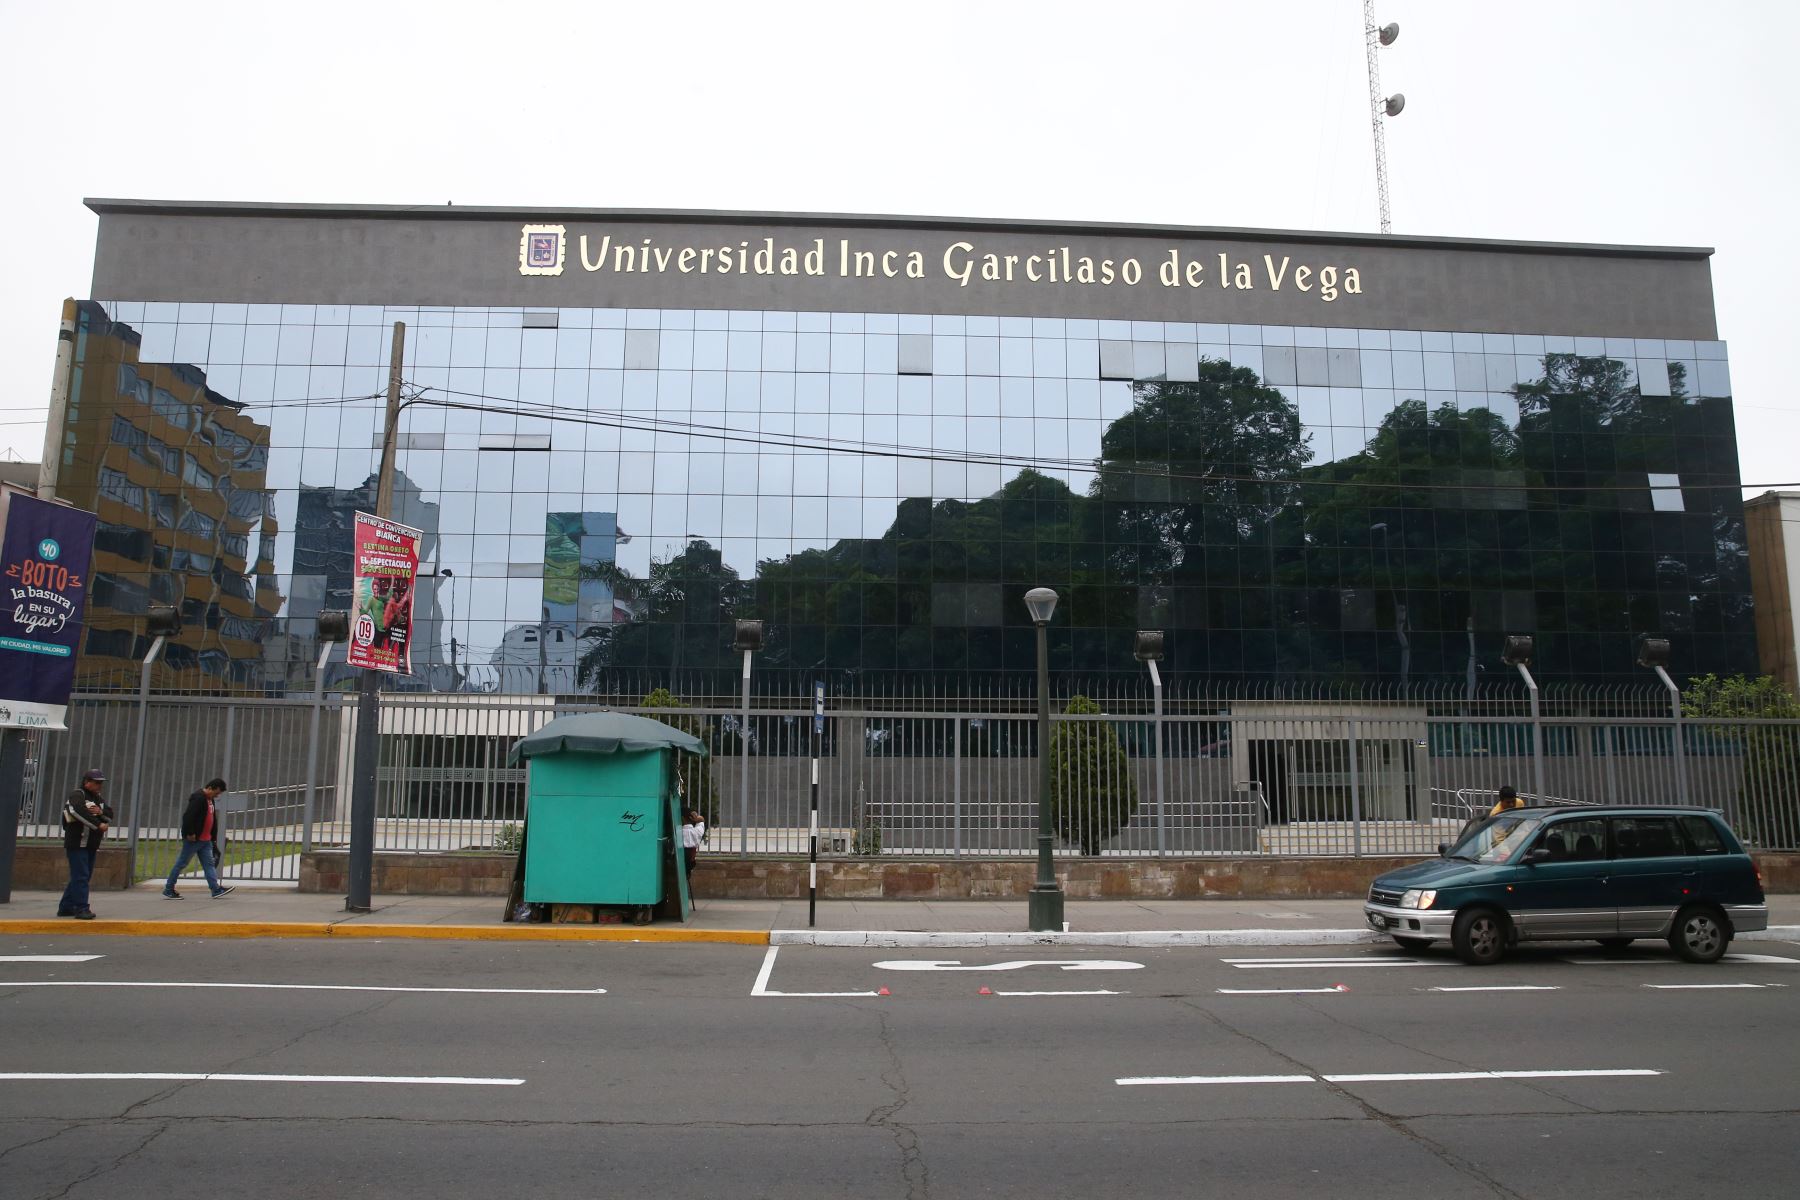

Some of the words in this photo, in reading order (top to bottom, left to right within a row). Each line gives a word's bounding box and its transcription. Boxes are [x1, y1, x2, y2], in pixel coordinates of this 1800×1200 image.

[580, 234, 825, 276] Universidad
[840, 239, 926, 279] Inca
[942, 241, 1142, 287] Garcilaso
[1159, 248, 1204, 288] de
[1217, 252, 1254, 290] la
[1263, 254, 1363, 302] Vega
[375, 529, 401, 543] BIANCA
[42, 543, 57, 557] YO
[363, 543, 389, 551] BETTINA
[360, 556, 369, 564] EL
[21, 559, 68, 592] BOTO
[377, 567, 401, 576] SIENDO
[401, 569, 412, 578] YO
[10, 587, 26, 600] la
[27, 585, 71, 609] basura
[29, 603, 42, 613] EN
[43, 606, 55, 615] SU
[13, 603, 58, 633] lugar
[359, 621, 371, 639] 09
[42, 644, 68, 655] VALORES
[18, 715, 49, 727] LIMA
